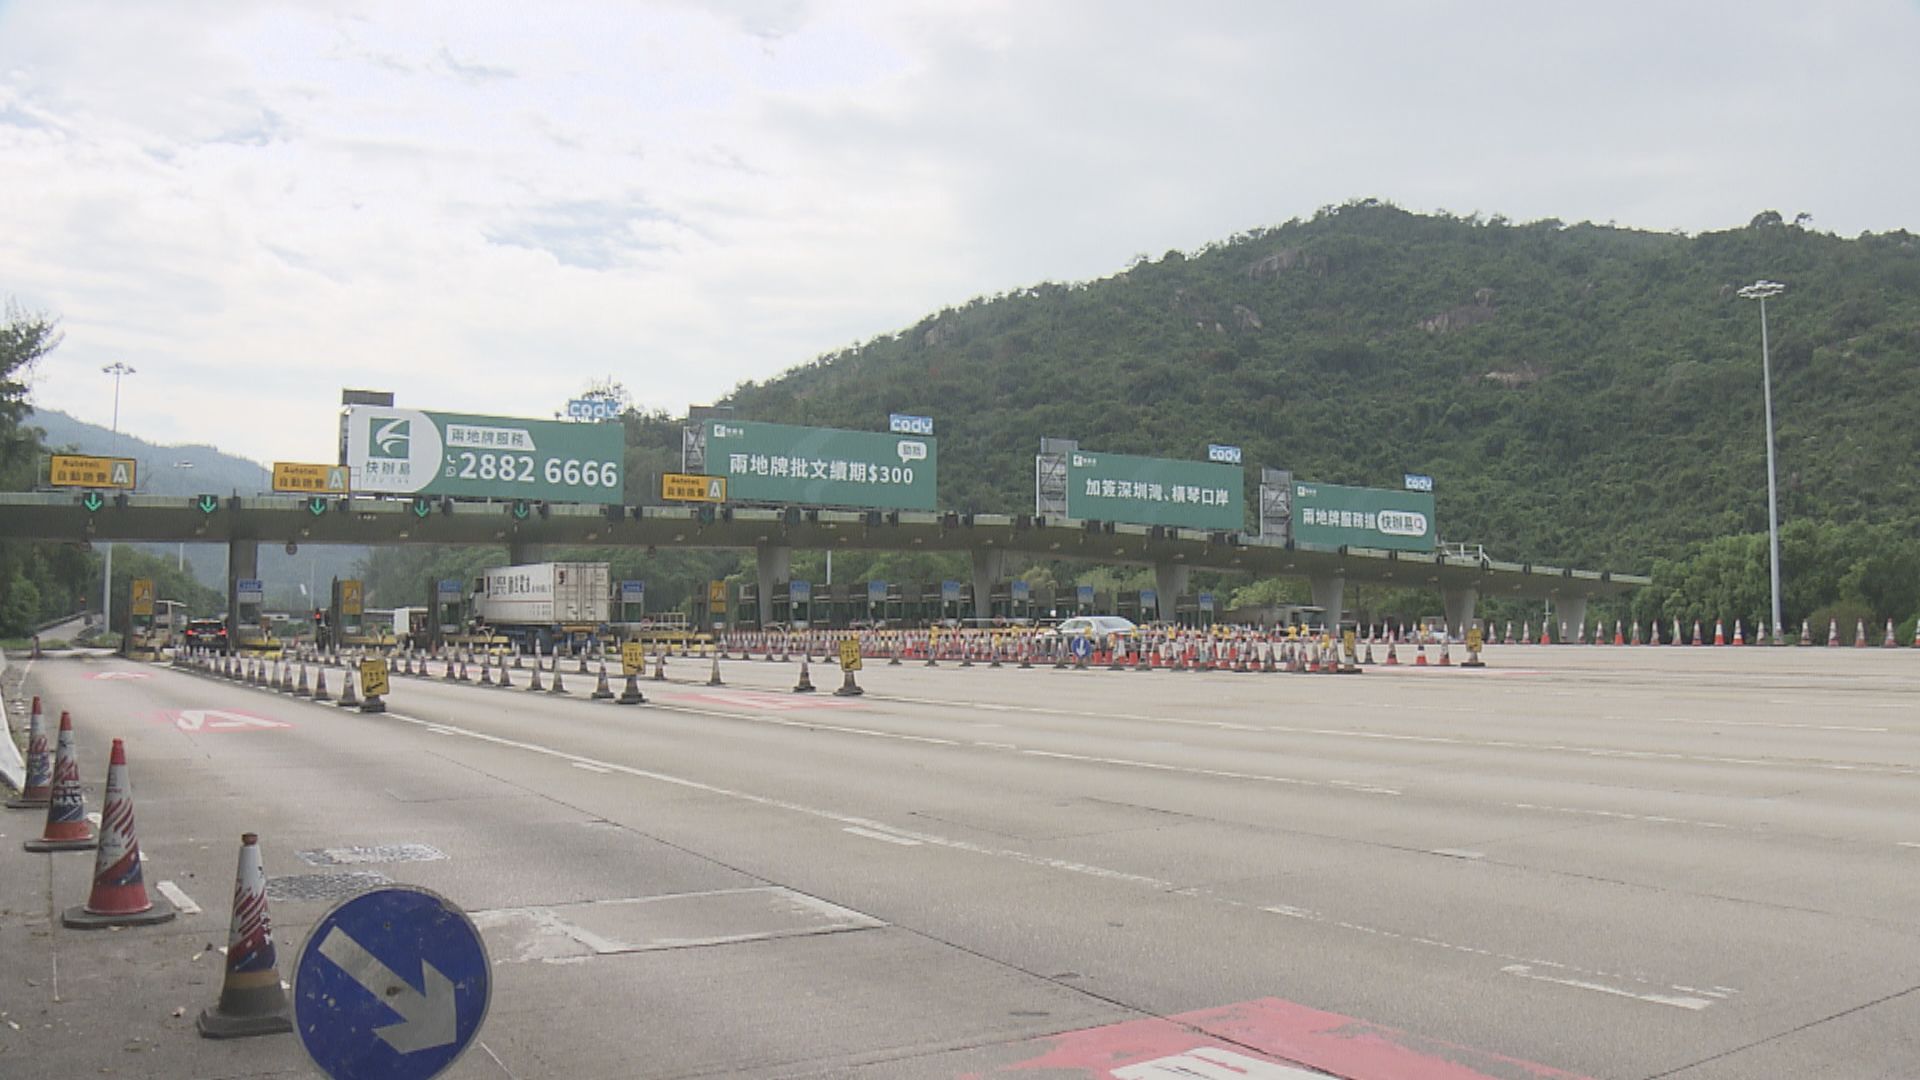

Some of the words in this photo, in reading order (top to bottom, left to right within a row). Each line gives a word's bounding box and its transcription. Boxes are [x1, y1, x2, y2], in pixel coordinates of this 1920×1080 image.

[890, 417, 933, 433] cody
[452, 428, 524, 447] 兩地牌服務
[112, 463, 129, 484] A
[459, 452, 535, 482] 2882
[545, 458, 617, 487] 6666
[730, 454, 913, 484] 兩地牌批文續期$300
[329, 470, 344, 489] A
[709, 481, 721, 497] A
